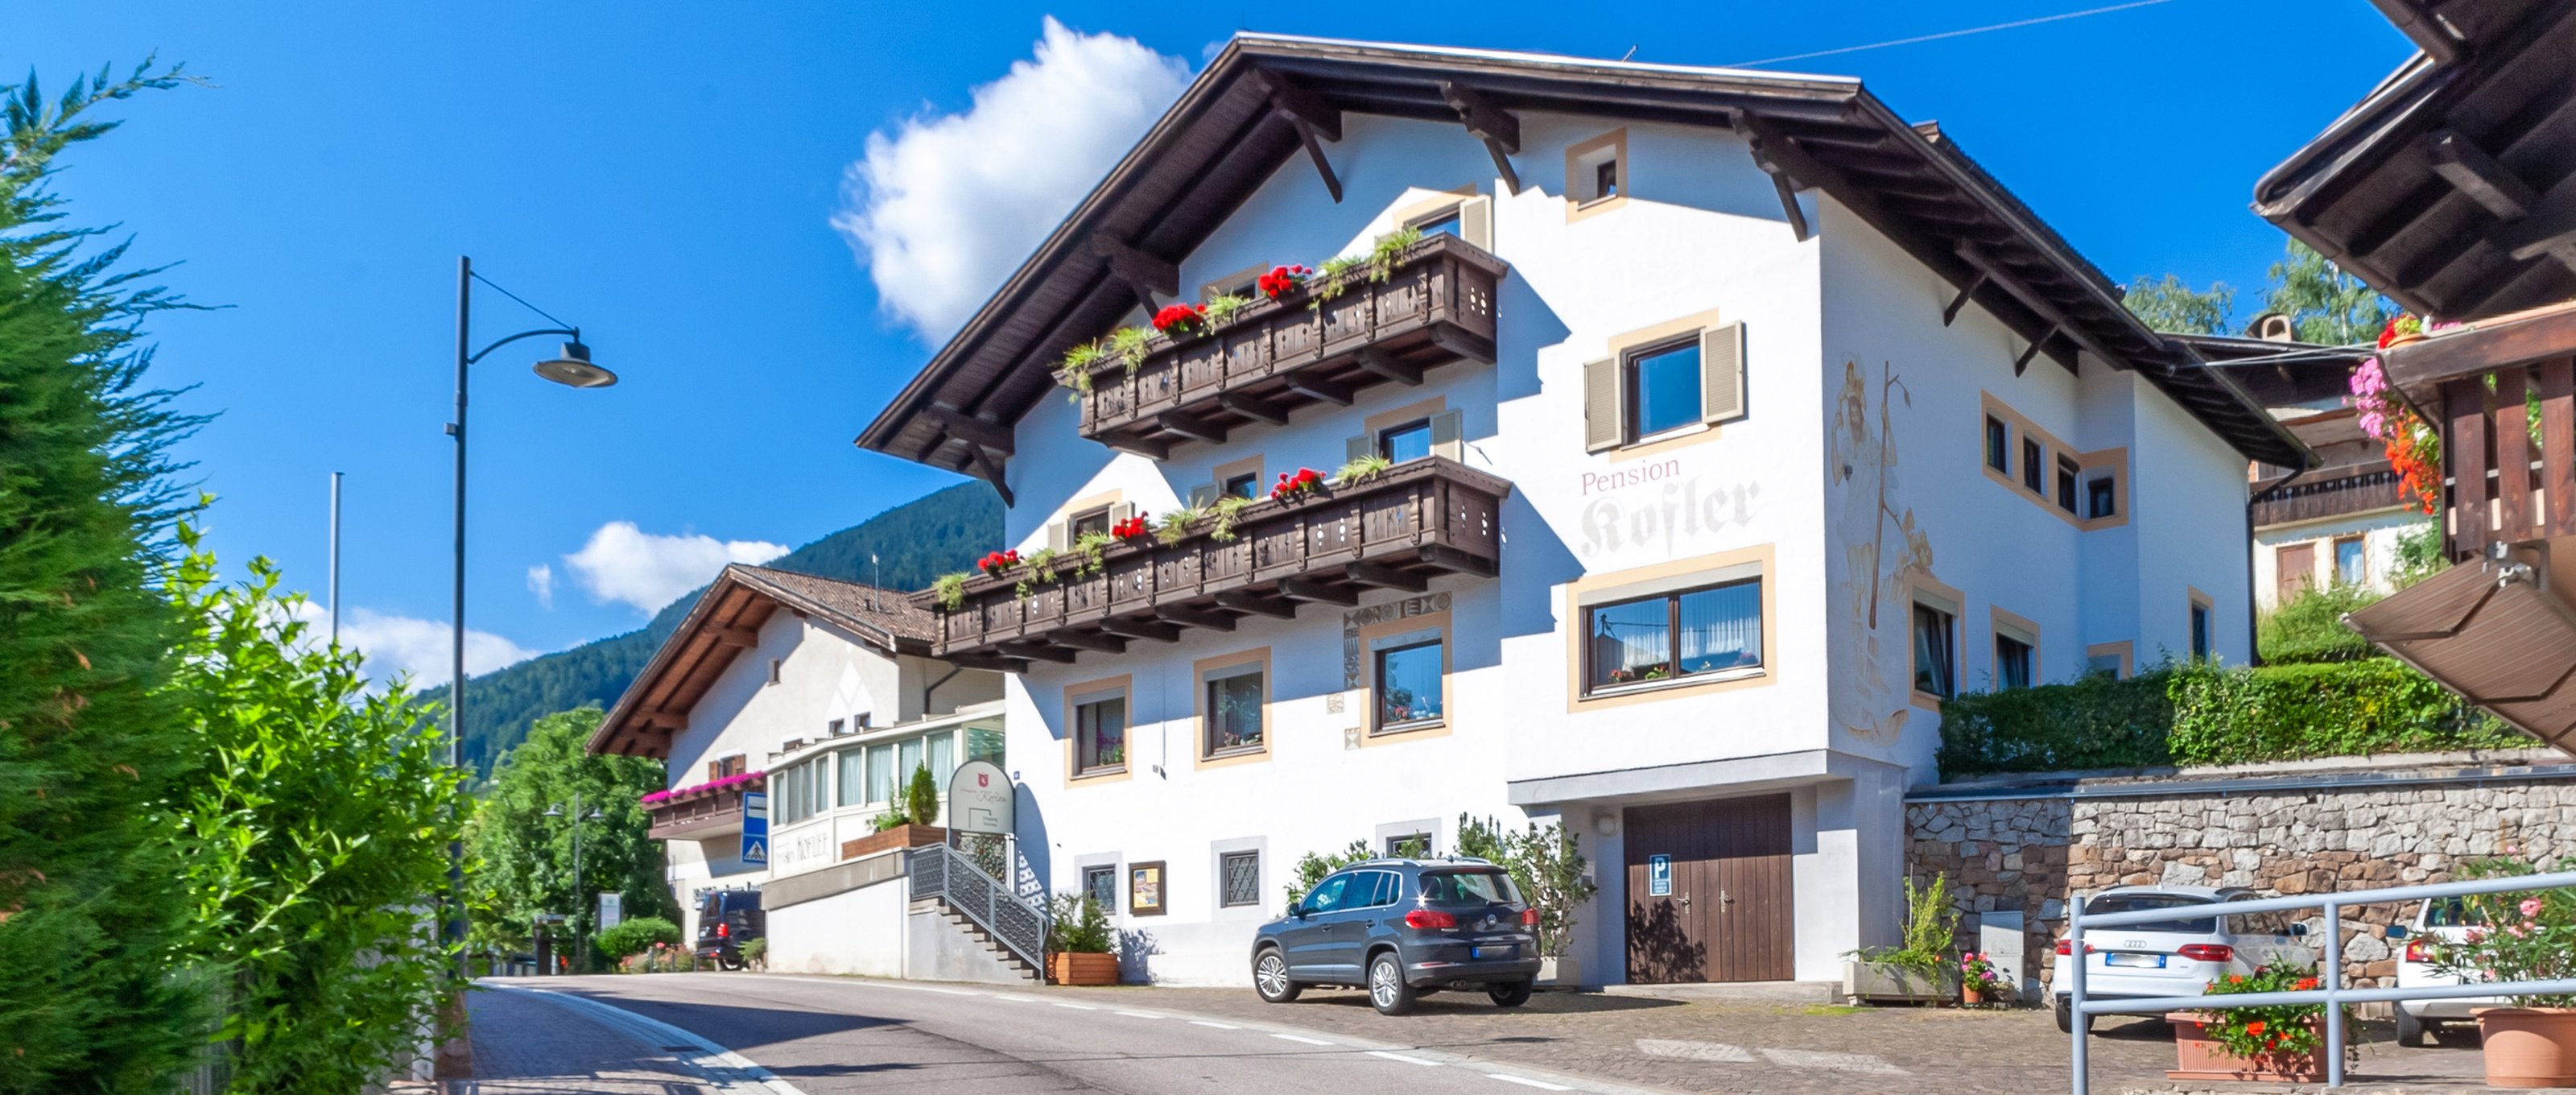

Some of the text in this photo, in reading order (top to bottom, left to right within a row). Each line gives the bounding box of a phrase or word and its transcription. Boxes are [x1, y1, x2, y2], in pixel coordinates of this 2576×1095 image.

[1582, 459, 1680, 496] Pension
[1581, 475, 1761, 559] Kofler
[1654, 857, 1666, 878] P
